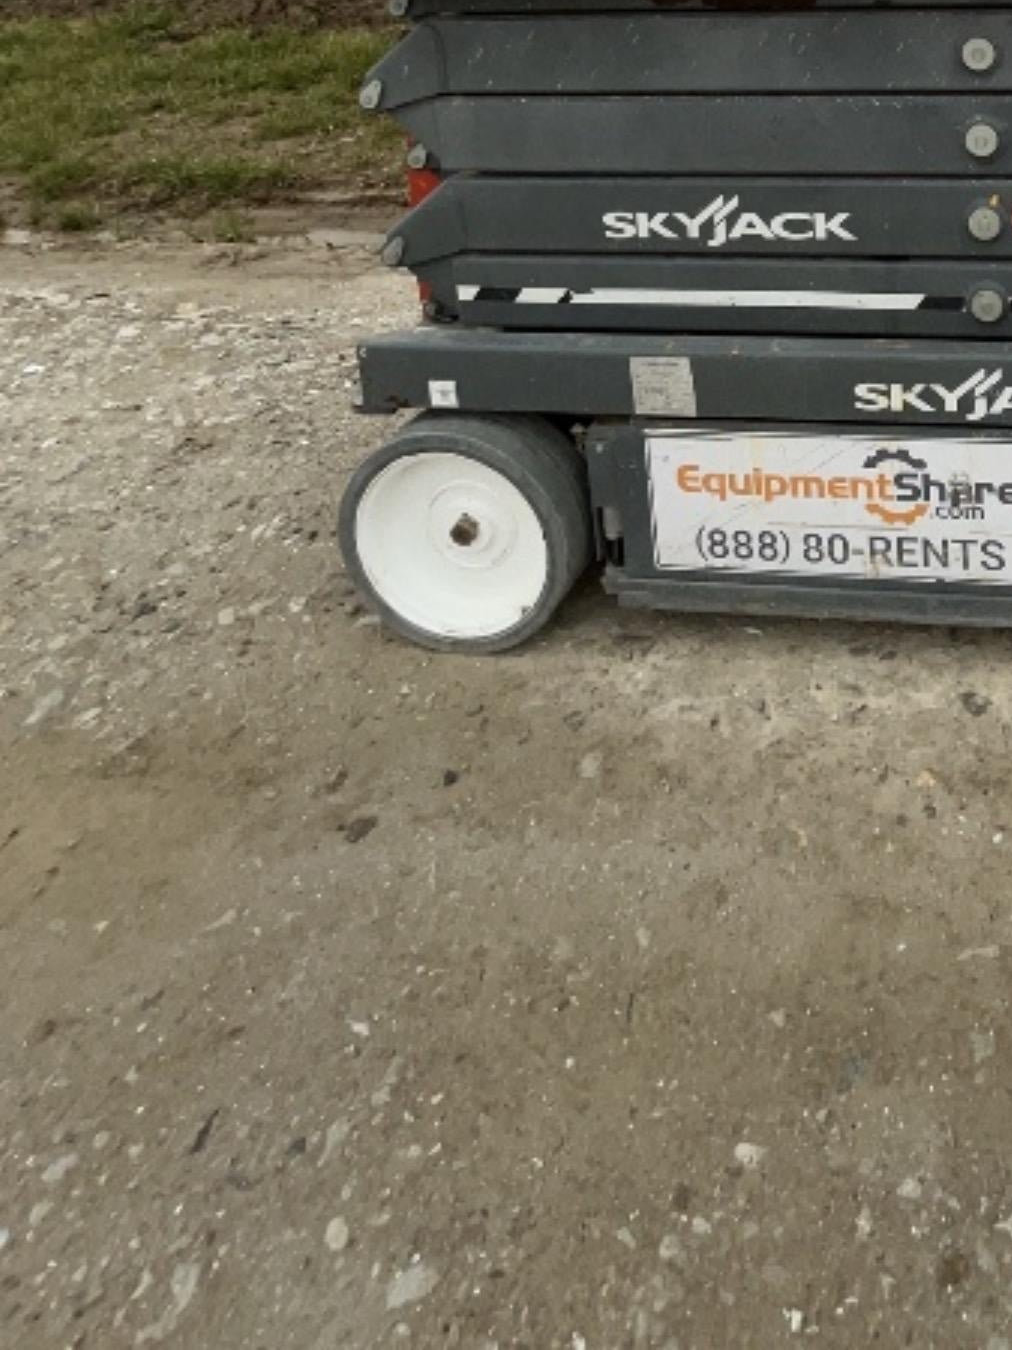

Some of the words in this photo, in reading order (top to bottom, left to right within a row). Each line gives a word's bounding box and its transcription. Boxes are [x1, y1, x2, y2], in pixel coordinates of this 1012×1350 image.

[601, 194, 859, 247] SKYJACK
[695, 527, 791, 565] (888)
[802, 532, 1007, 573] 80-RENTS
